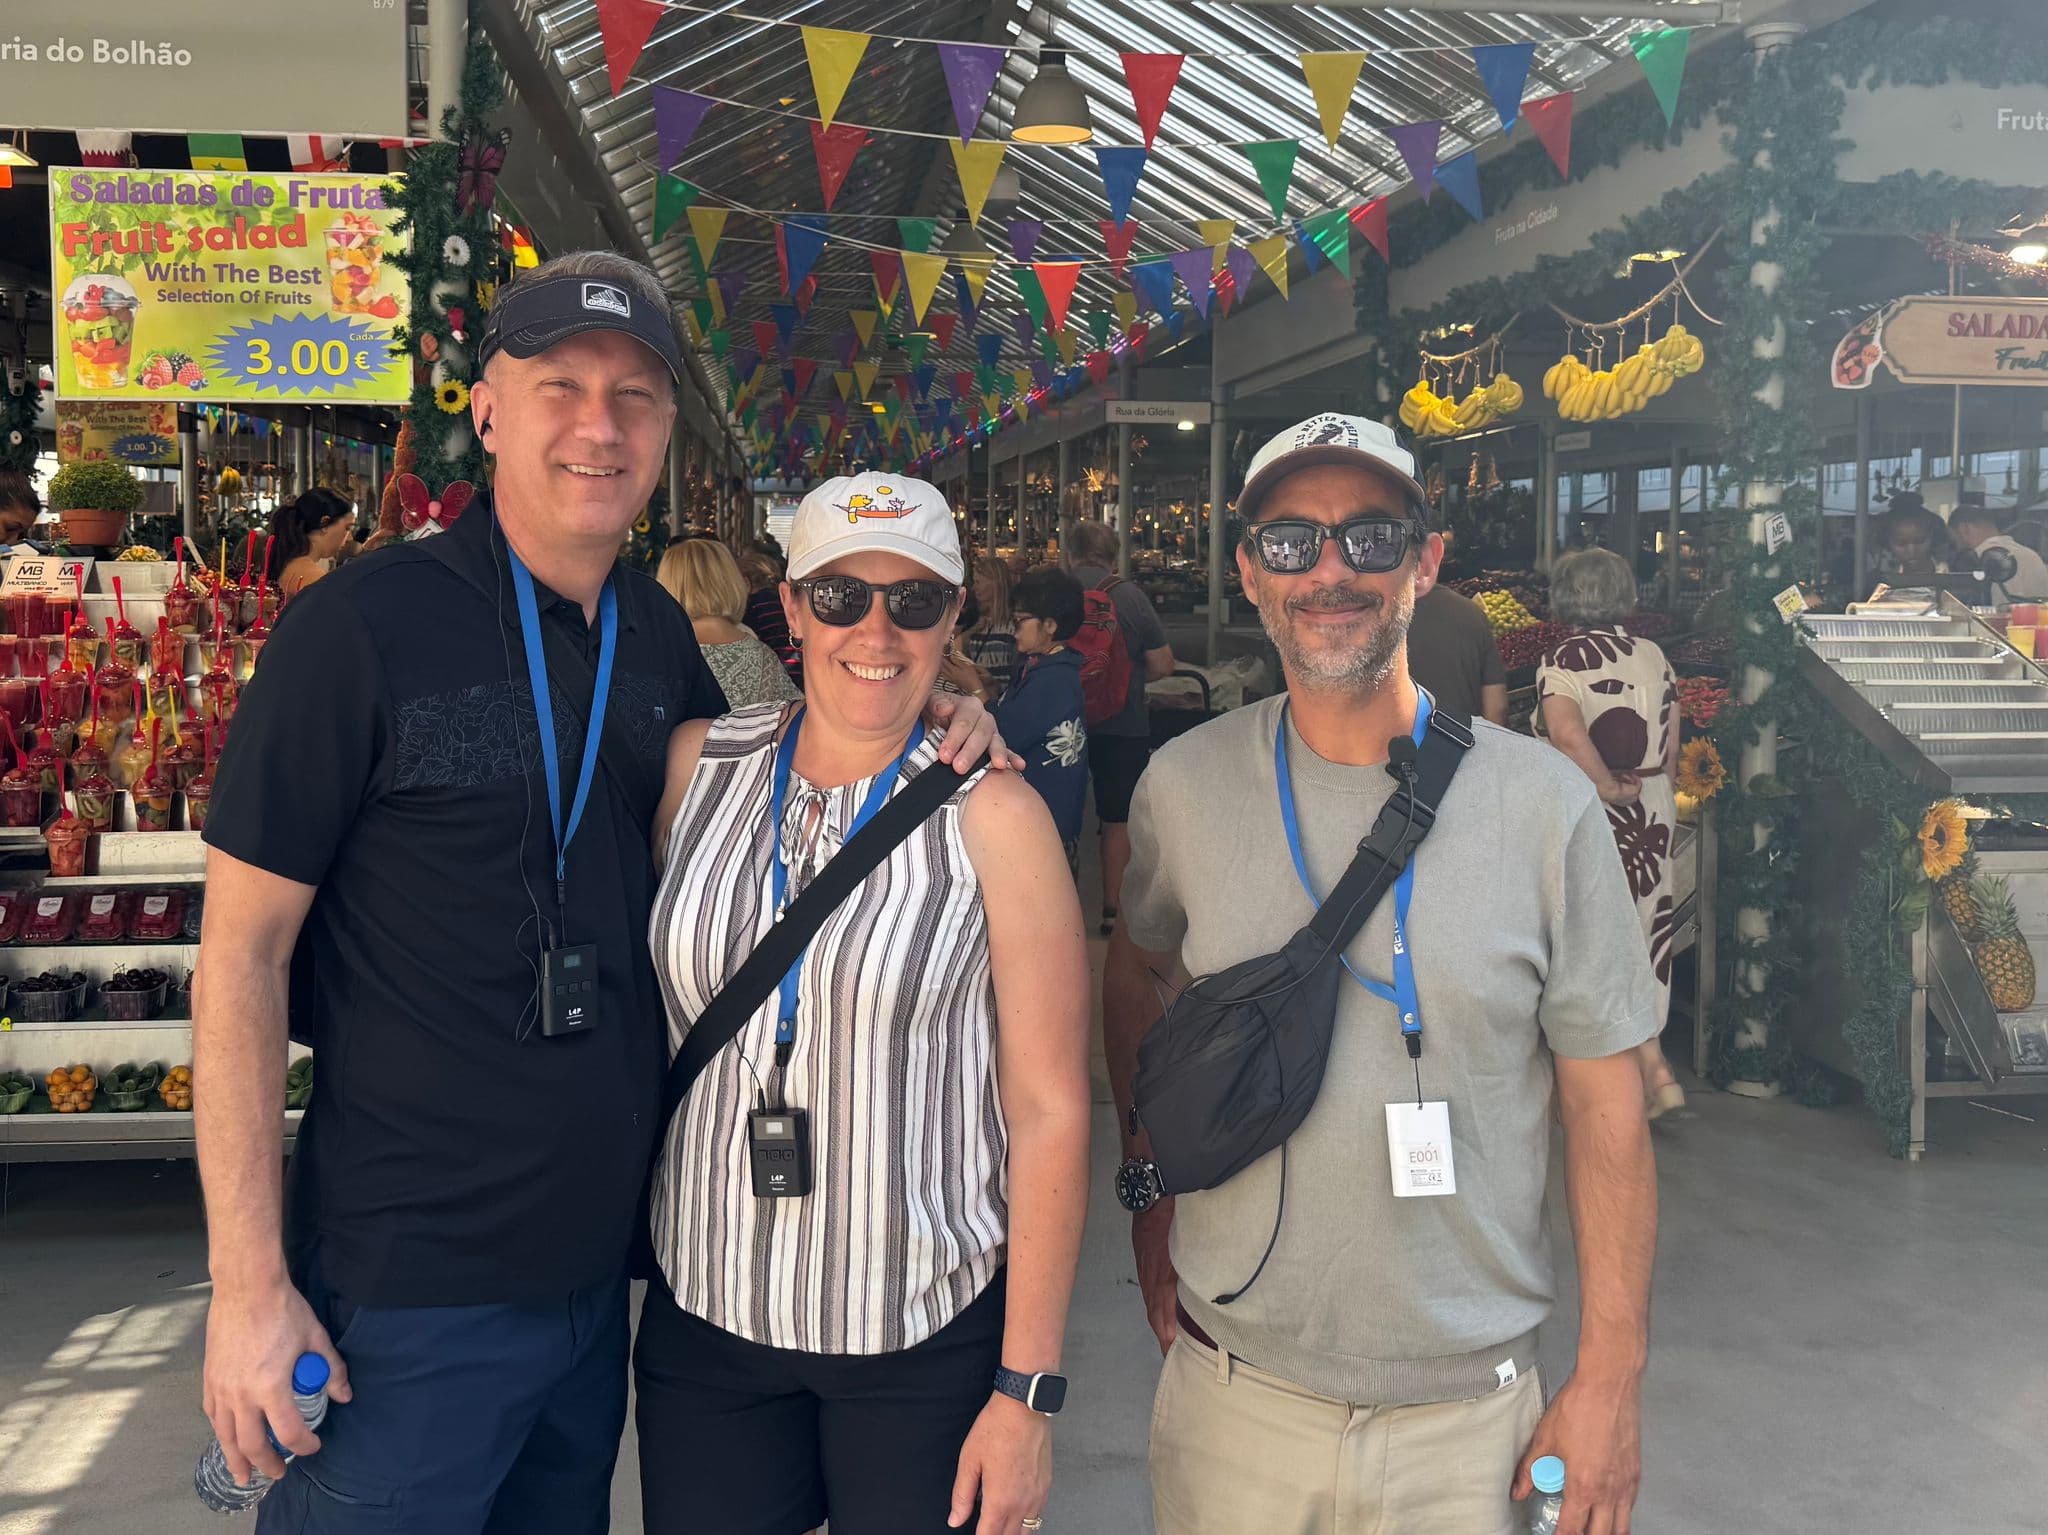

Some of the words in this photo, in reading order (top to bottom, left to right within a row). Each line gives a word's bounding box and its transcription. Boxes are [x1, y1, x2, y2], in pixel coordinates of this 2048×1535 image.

[47, 38, 83, 63] do
[93, 38, 192, 66] Bolhão
[1997, 108, 2048, 131] Frut
[70, 174, 218, 208] Saladas
[231, 180, 275, 208] de
[289, 180, 388, 210] Fruta
[62, 220, 175, 257] Fruit
[188, 214, 308, 252] salad
[145, 263, 206, 282] With
[214, 263, 261, 283] The
[269, 264, 322, 285] Best
[157, 288, 235, 305] Selection
[240, 289, 261, 305] Of
[265, 290, 312, 305] Fruits
[350, 333, 374, 341] Cada
[246, 338, 349, 376] 3.00
[355, 351, 370, 370] €
[1115, 407, 1132, 416] Rua
[1134, 407, 1145, 416] da
[1147, 407, 1175, 416] Glória
[1301, 416, 1337, 434] BETTER
[1772, 521, 1784, 538] MB
[17, 566, 43, 576] MB
[58, 567, 78, 576] M
[1409, 1150, 1439, 1163] E001
